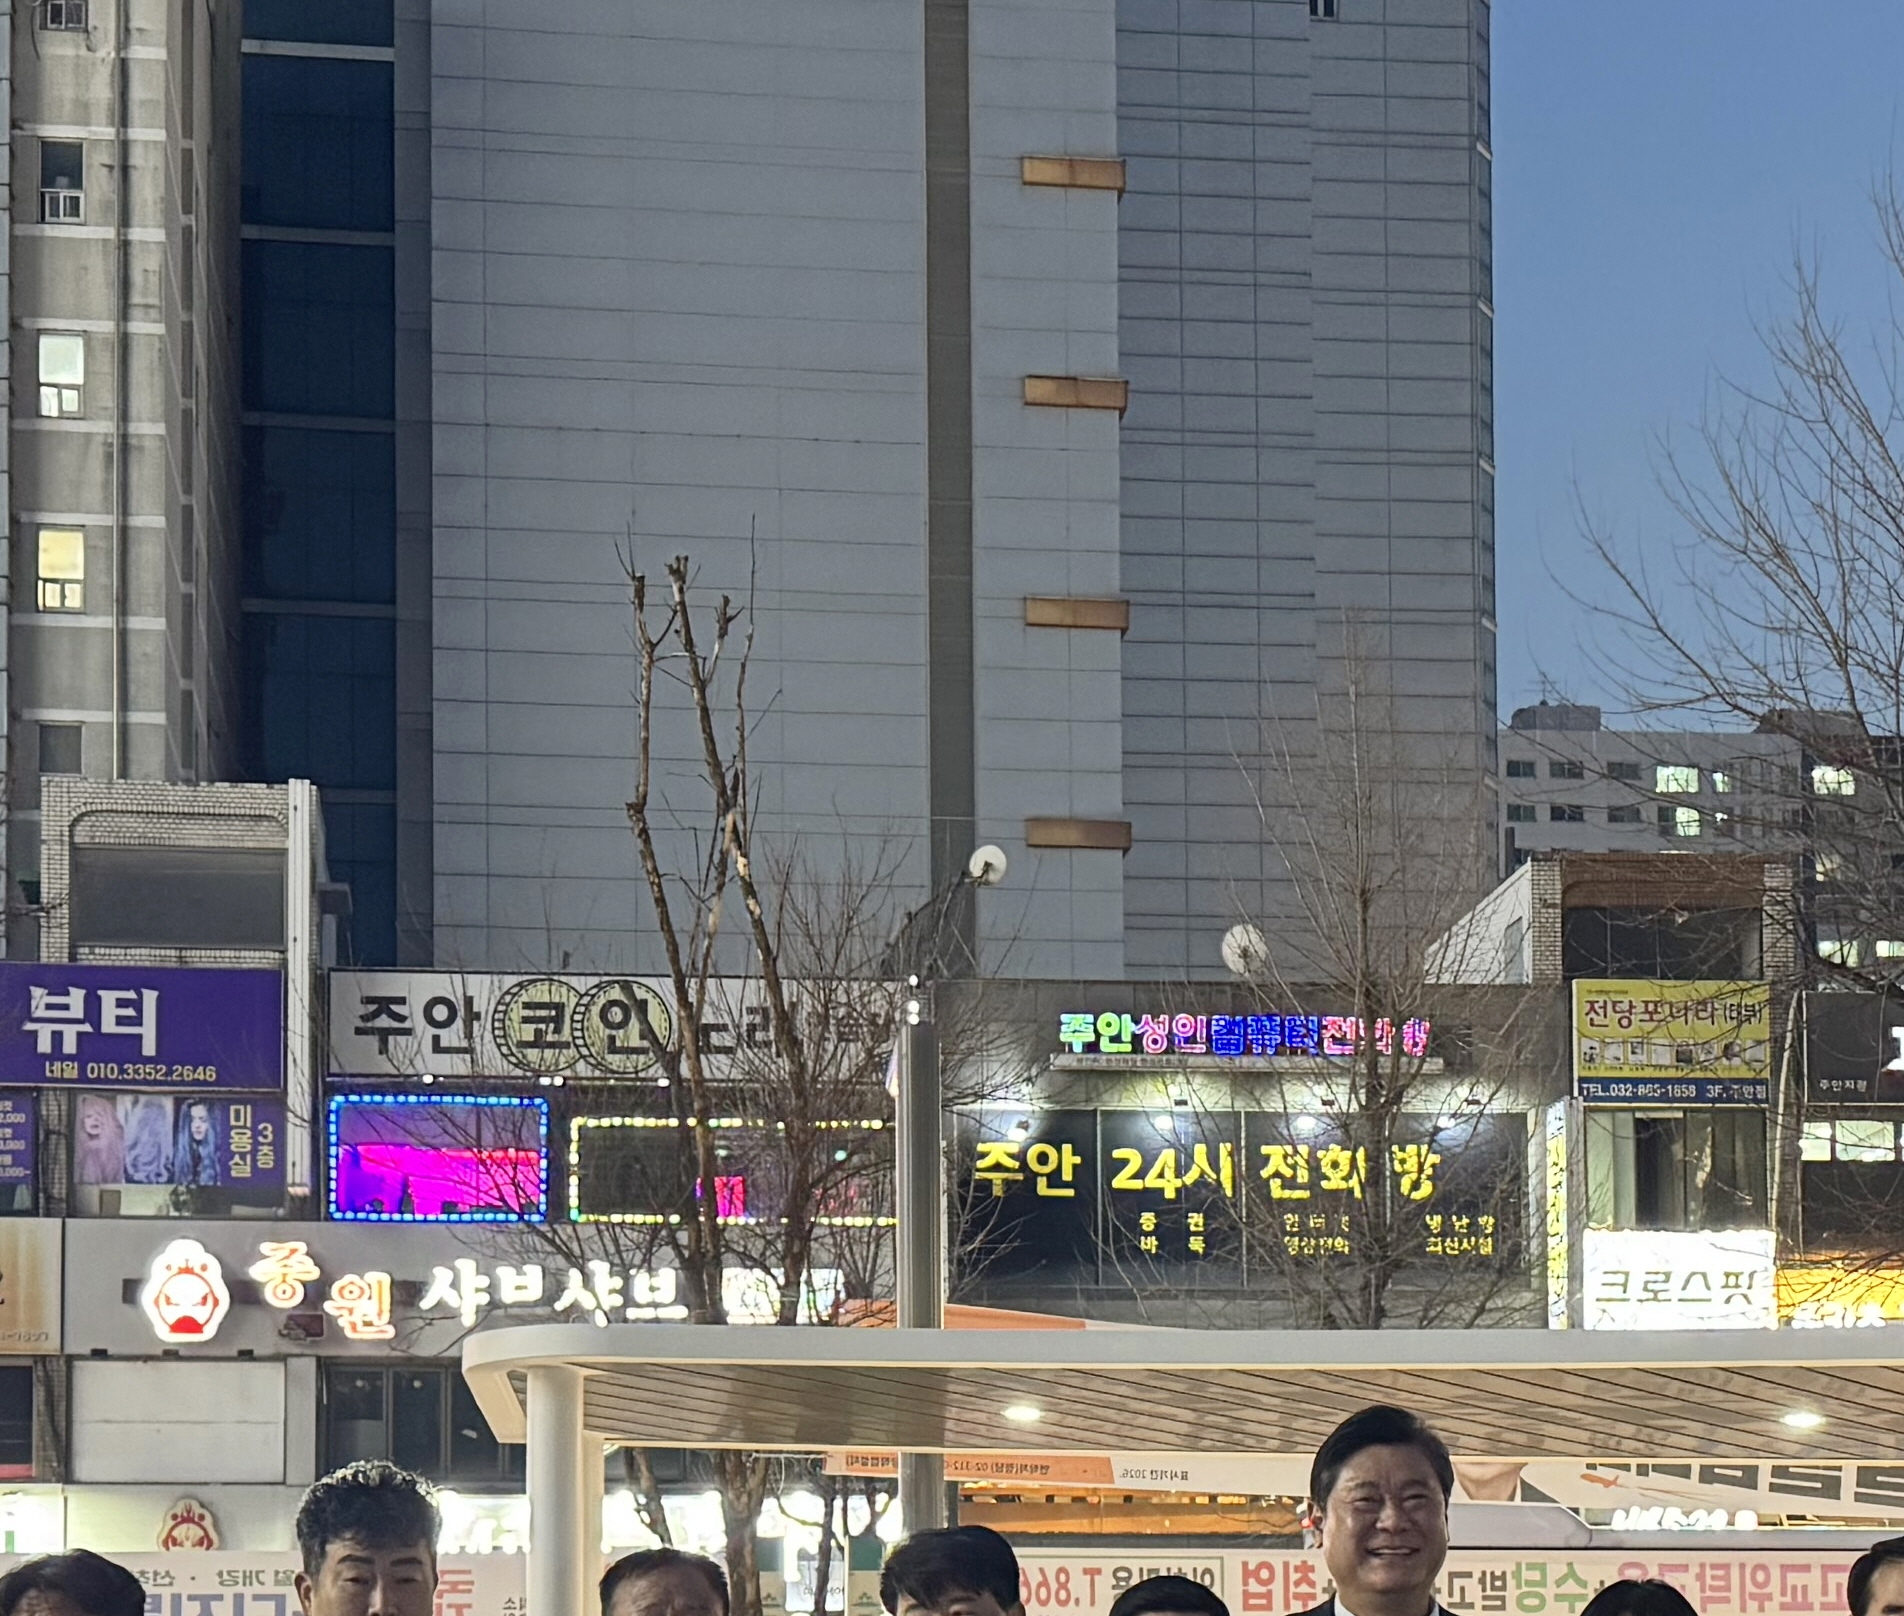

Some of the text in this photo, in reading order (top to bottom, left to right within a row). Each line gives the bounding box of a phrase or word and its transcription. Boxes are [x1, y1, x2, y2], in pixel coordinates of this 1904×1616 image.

[22, 985, 161, 1057] 뷰티
[354, 994, 481, 1056] 주안
[518, 995, 652, 1054] 코인
[44, 1061, 217, 1084] 네일 010.3352.2646
[228, 1103, 253, 1178] 미용실
[256, 1121, 274, 1169] 3층
[974, 1141, 1082, 1197] 주안
[1111, 1141, 1234, 1200] 24시
[1594, 1266, 1758, 1307] 크로스핏
